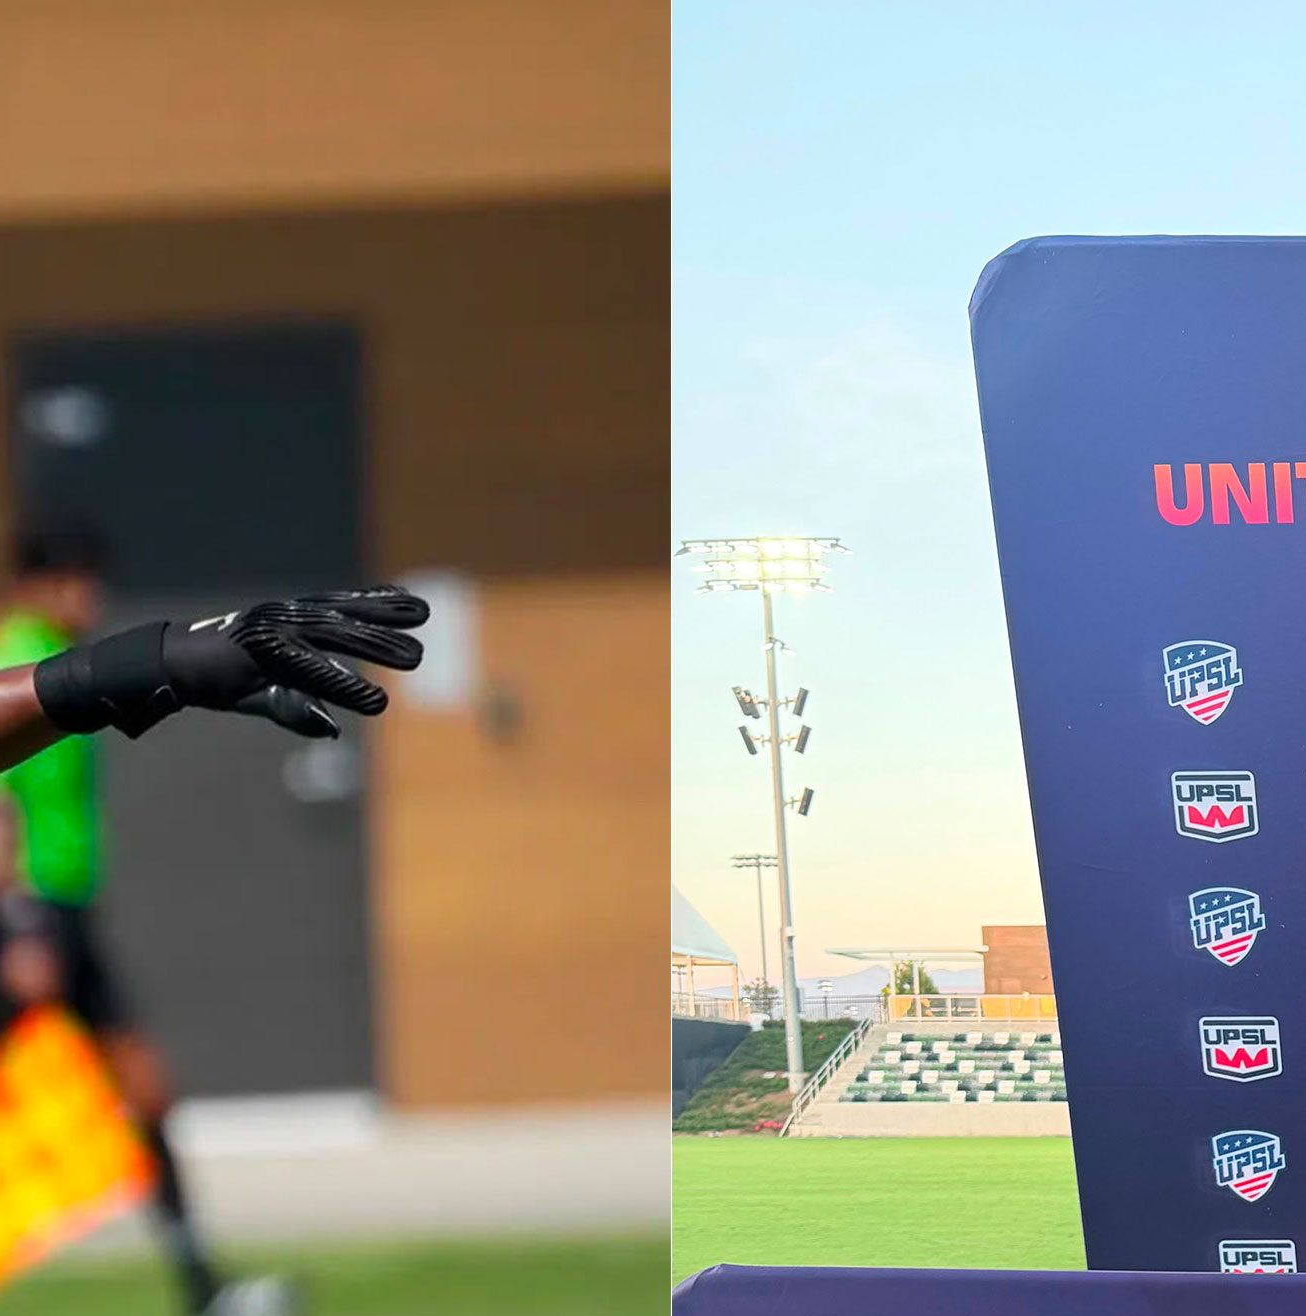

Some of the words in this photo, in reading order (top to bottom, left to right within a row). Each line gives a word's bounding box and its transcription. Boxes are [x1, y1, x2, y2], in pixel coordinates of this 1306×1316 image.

[1167, 656, 1240, 704] UPSL
[1176, 785, 1252, 802] UPSL
[1193, 902, 1263, 946] UPSL
[1204, 1029, 1276, 1045] UPSL
[1216, 1145, 1283, 1183] UPSL
[1223, 1251, 1293, 1266] UPSL
